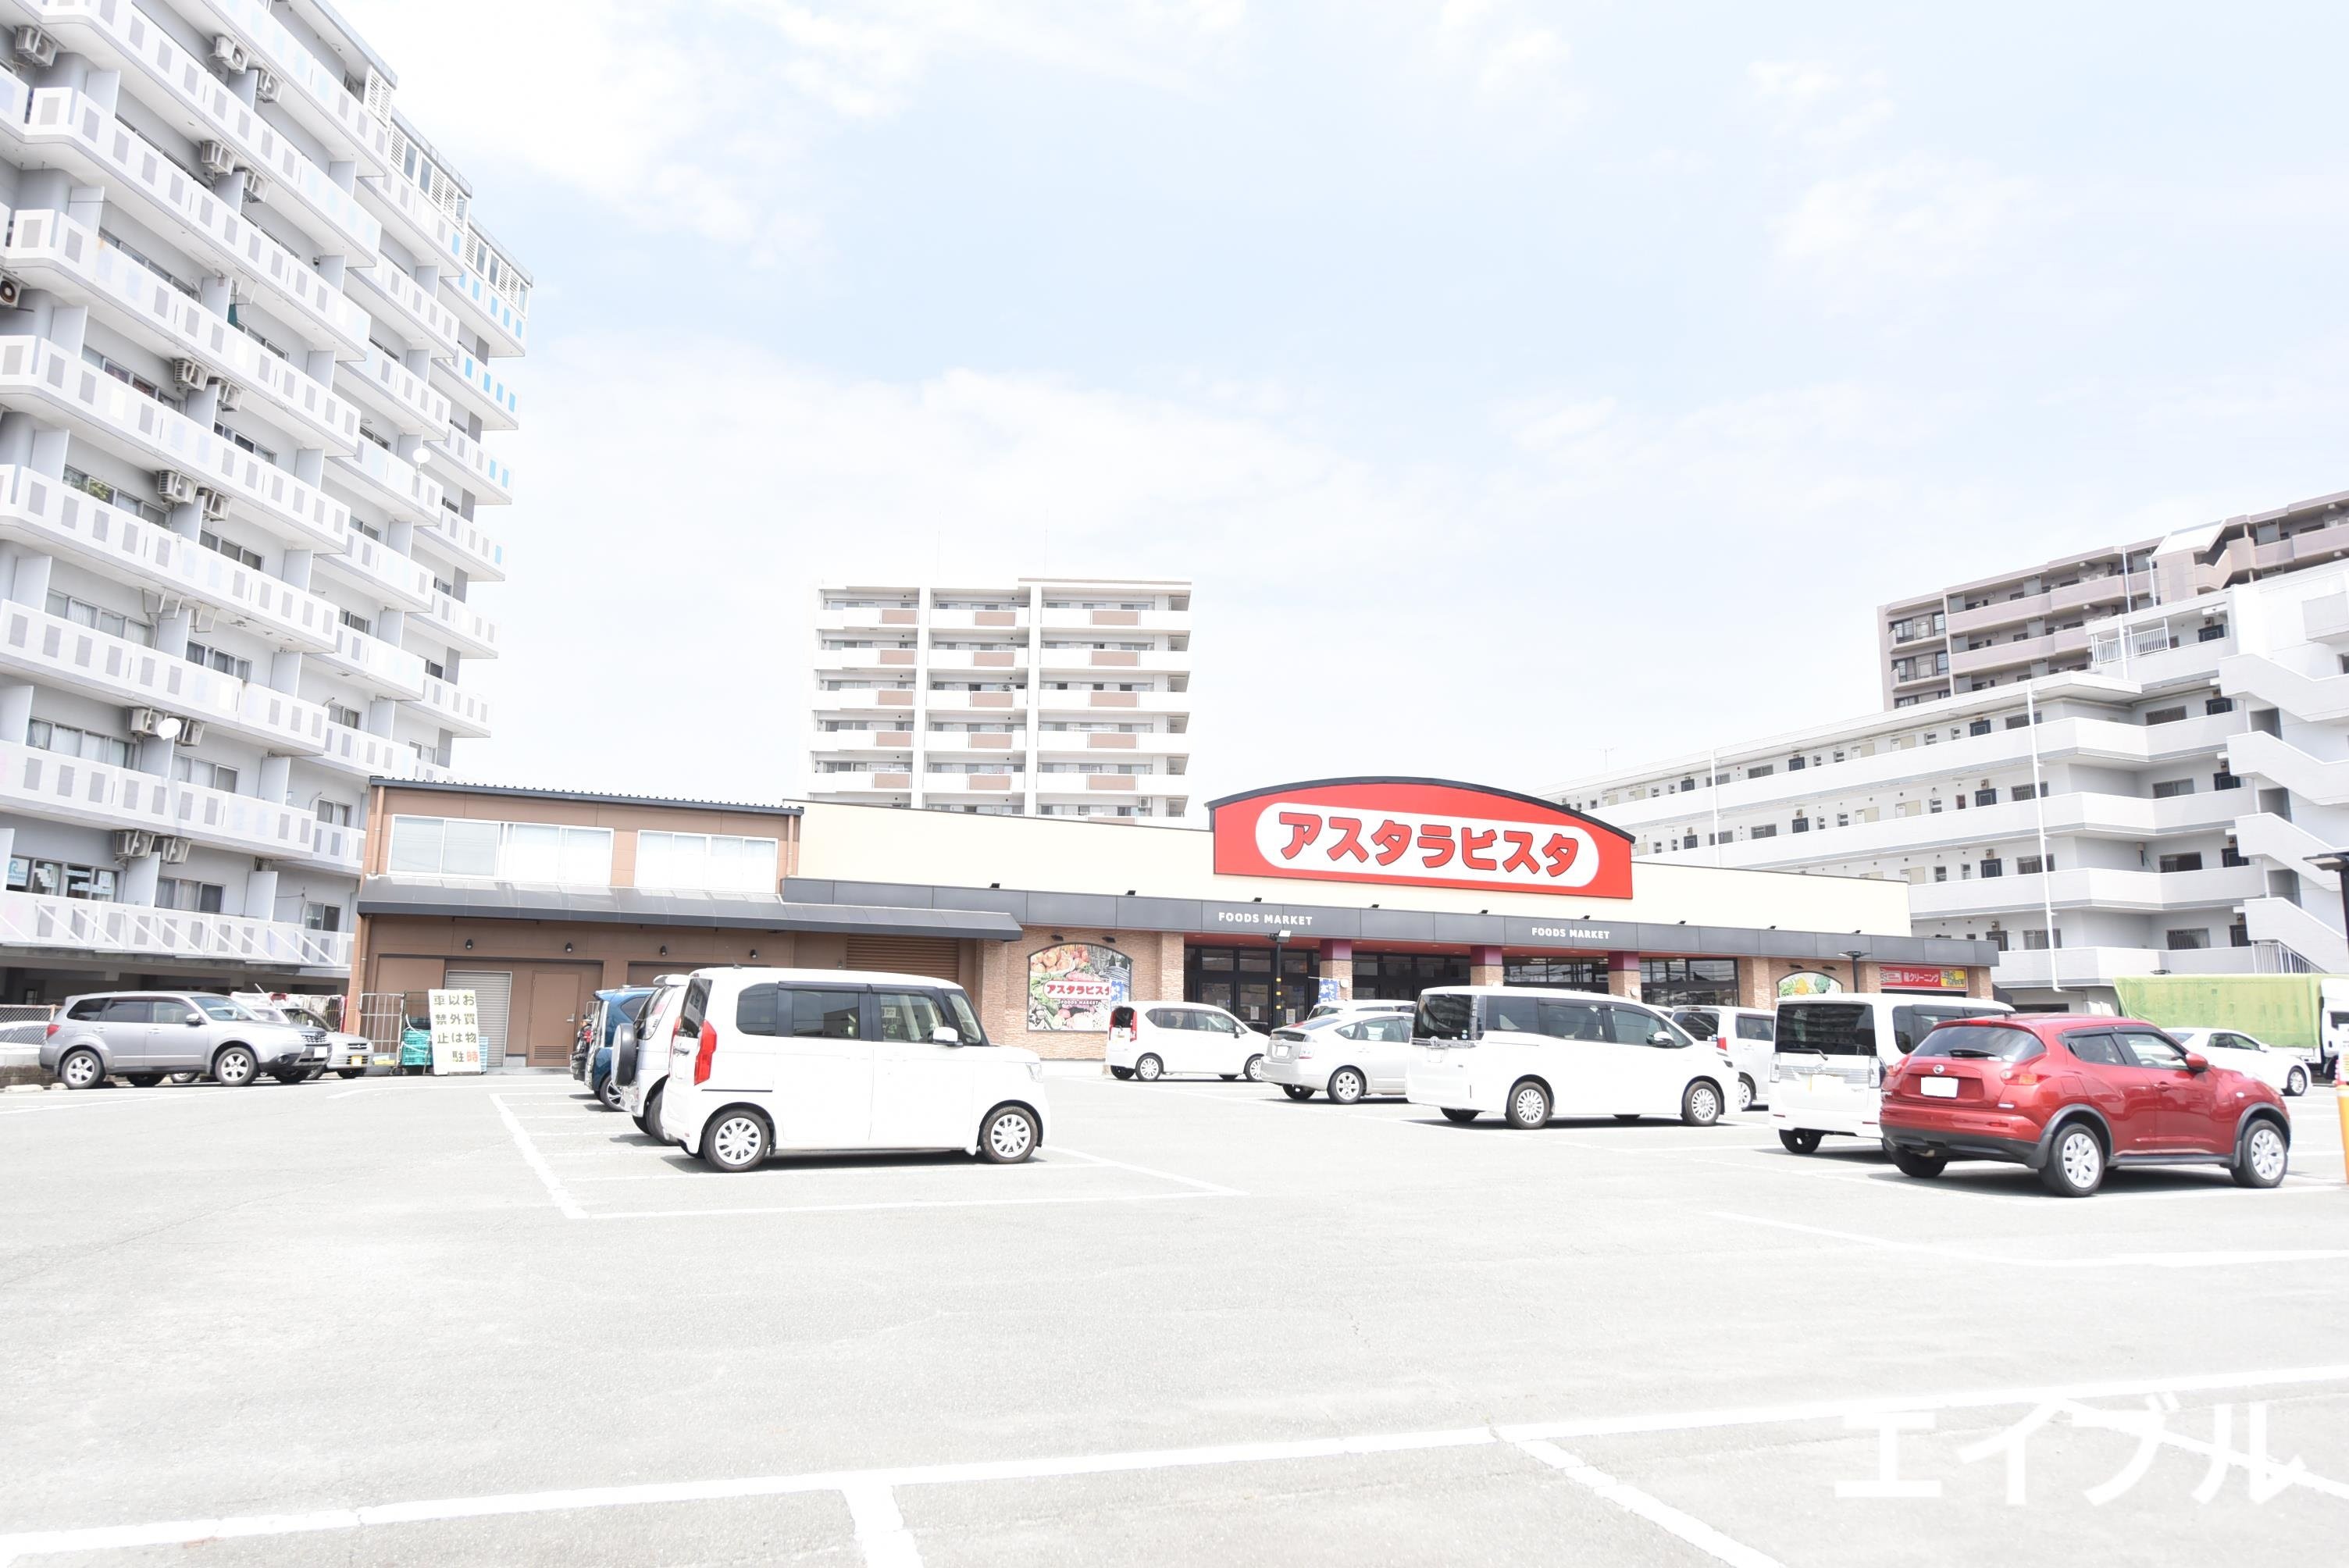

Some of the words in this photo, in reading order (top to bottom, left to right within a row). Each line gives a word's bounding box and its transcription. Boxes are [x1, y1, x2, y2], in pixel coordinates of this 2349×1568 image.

[1279, 811, 1578, 878] アスタラビスタ
[1218, 912, 1260, 923] FOODS
[1264, 914, 1313, 925] MARKET
[1531, 927, 1566, 938] FOODS
[1569, 929, 1610, 939] MARKET
